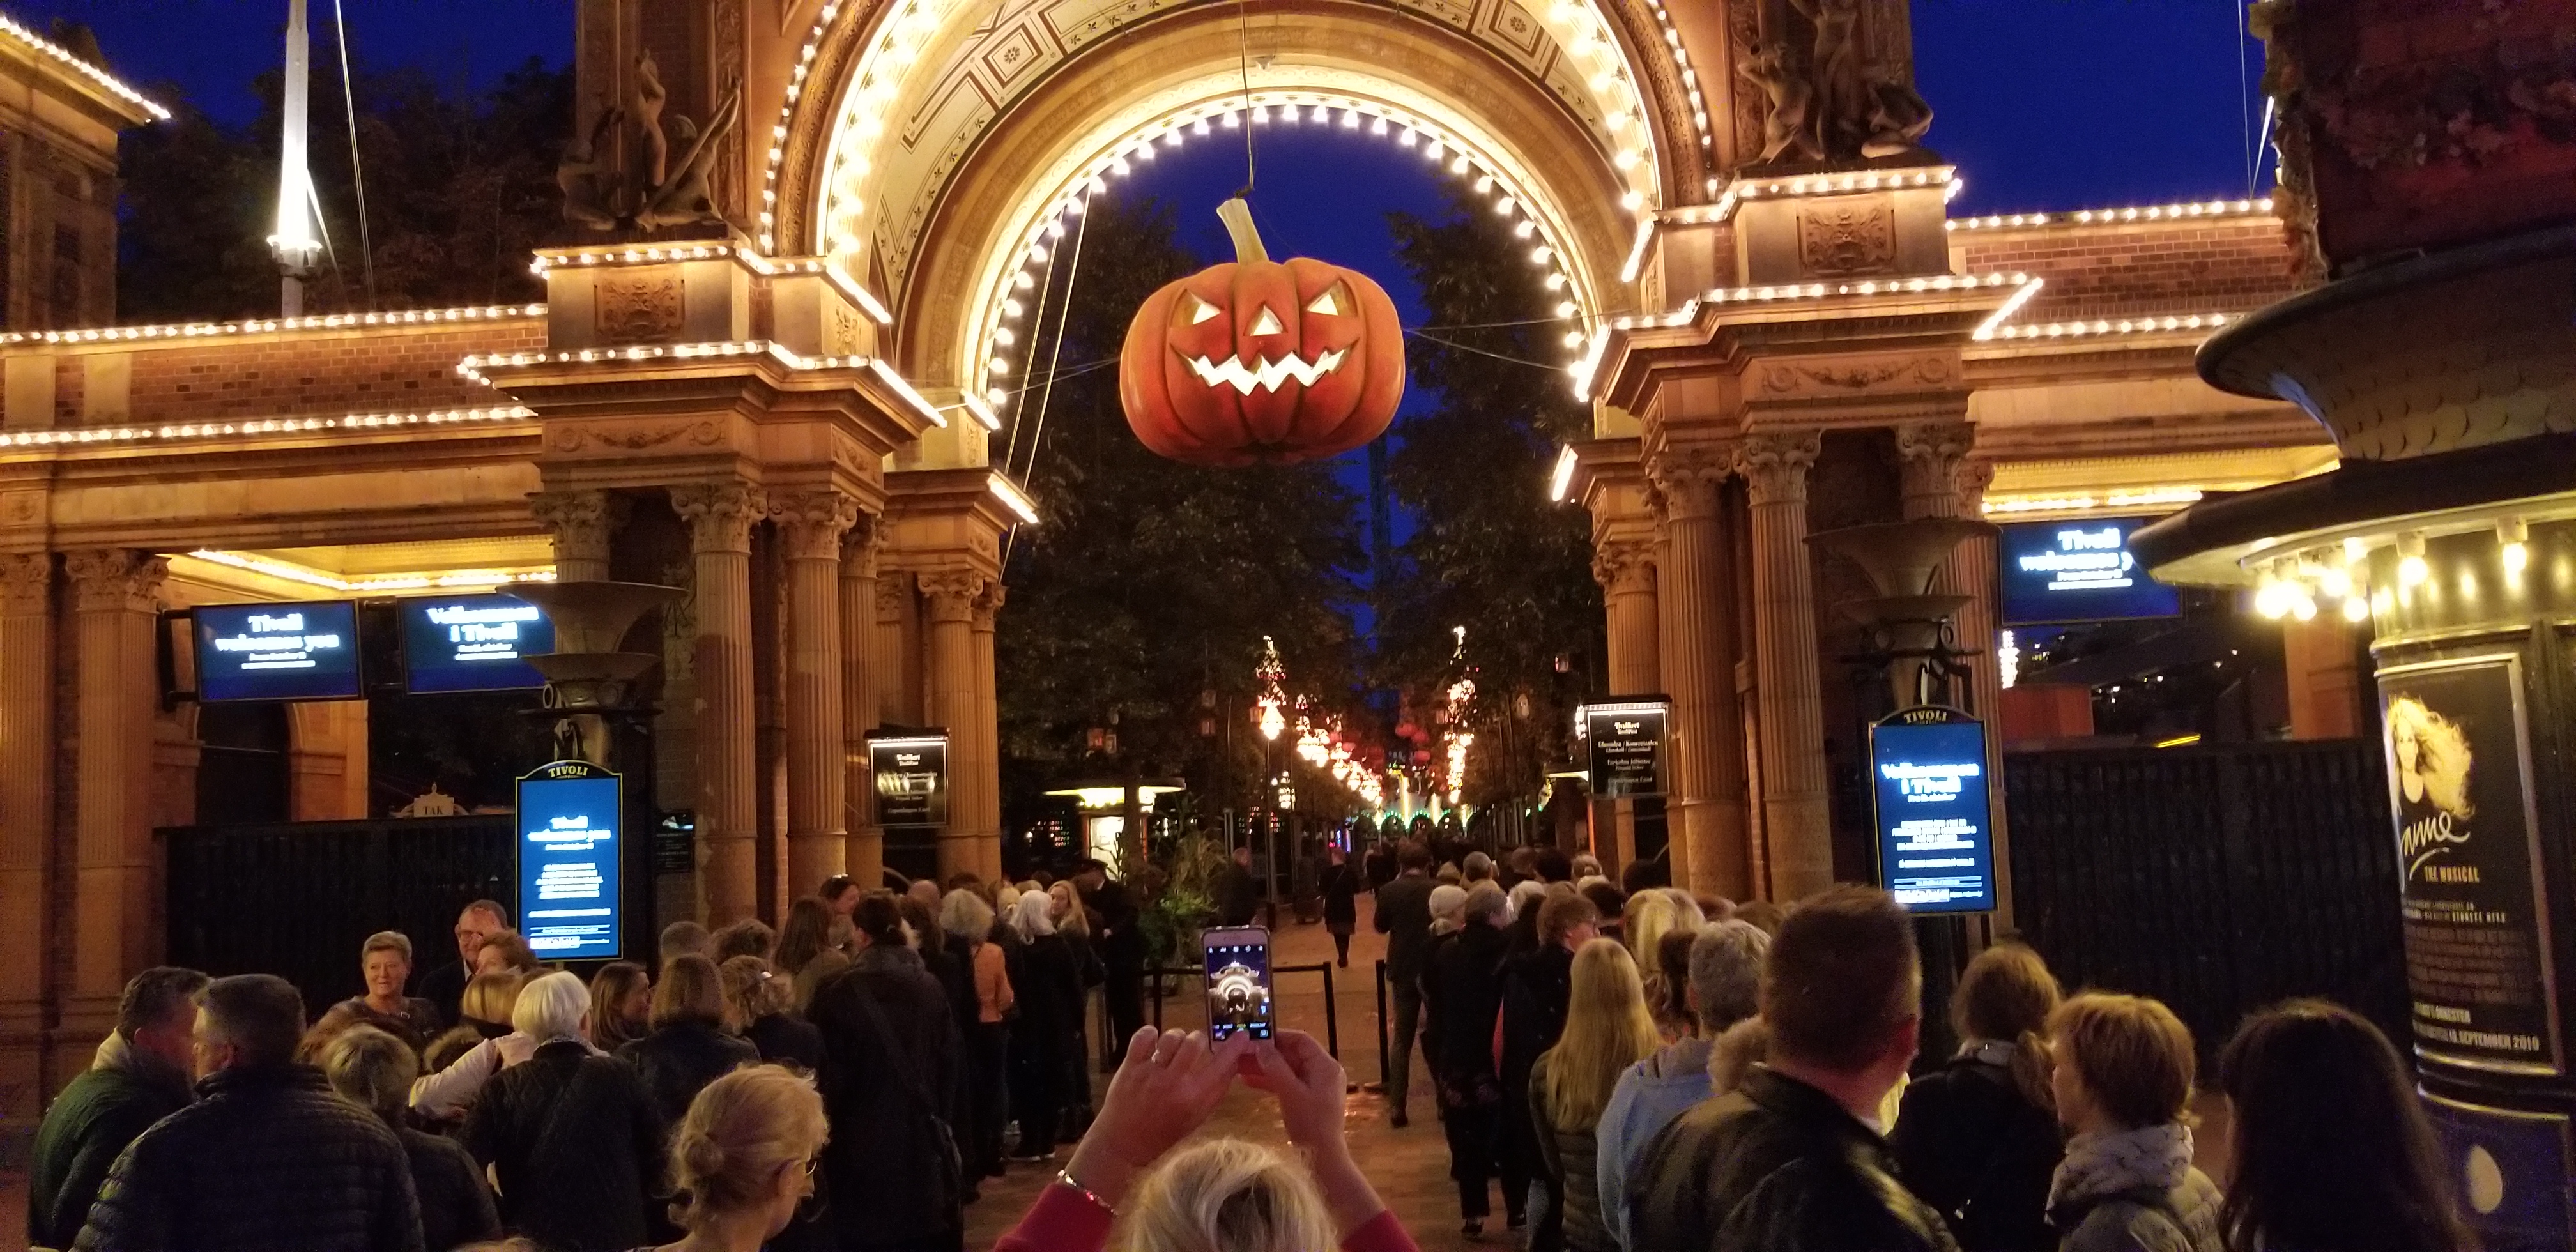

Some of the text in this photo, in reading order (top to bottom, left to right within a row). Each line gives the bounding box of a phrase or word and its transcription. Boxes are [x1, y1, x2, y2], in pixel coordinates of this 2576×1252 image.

[2058, 528, 2120, 550] Tivoli
[2020, 551, 2119, 571] welcomes
[248, 613, 303, 632] Tivoli
[461, 622, 518, 641] Tivoli
[215, 634, 339, 652] welcomes you
[1903, 710, 1947, 724] TIVOLI
[548, 765, 588, 777] TIVOLI
[1910, 777, 1961, 793] Tivoli
[424, 805, 443, 815] TAK
[550, 816, 588, 829] Tivoli
[2424, 866, 2480, 883] THE MUSICAL
